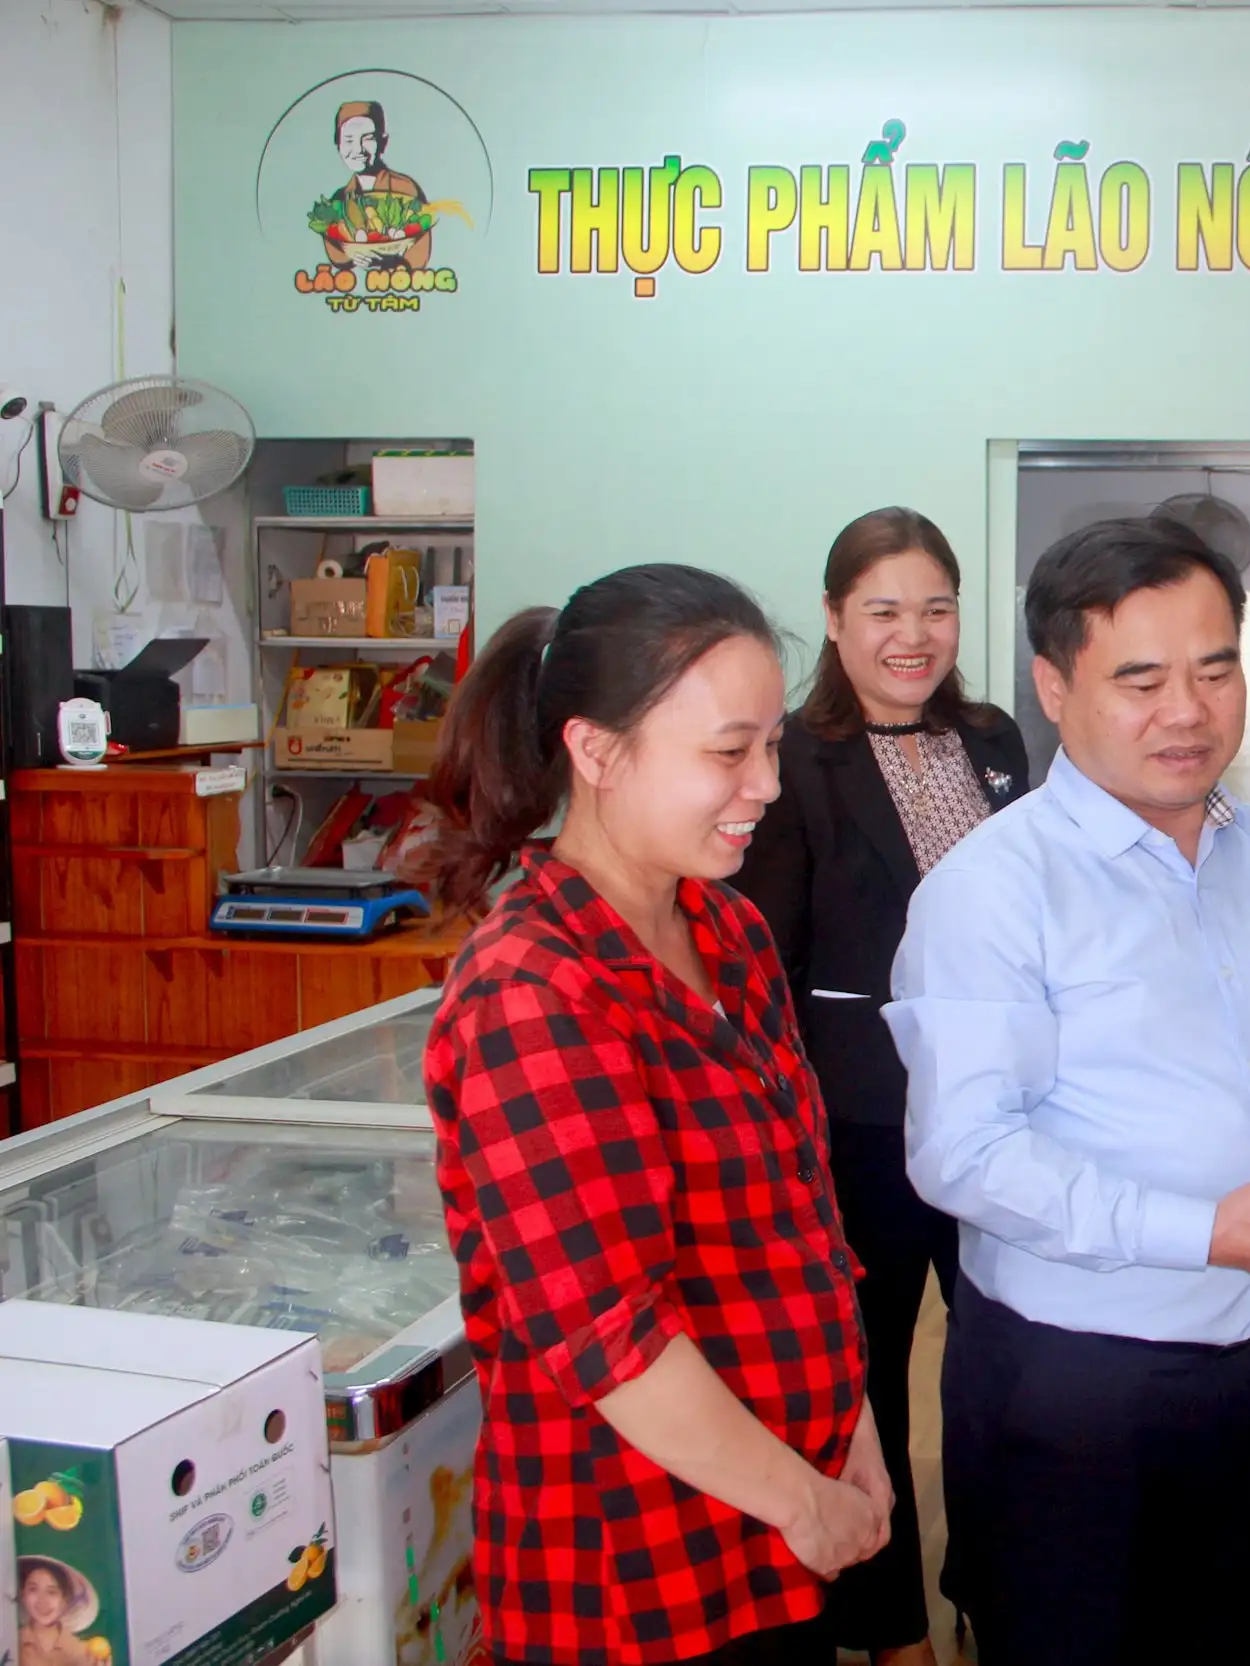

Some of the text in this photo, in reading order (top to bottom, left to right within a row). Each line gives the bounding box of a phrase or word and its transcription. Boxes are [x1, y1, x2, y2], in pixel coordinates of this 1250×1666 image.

[528, 155, 722, 297] THỰC
[746, 118, 976, 272] PHẨM
[1001, 139, 1150, 273] LÃO
[295, 264, 458, 293] LÃO NÔNG
